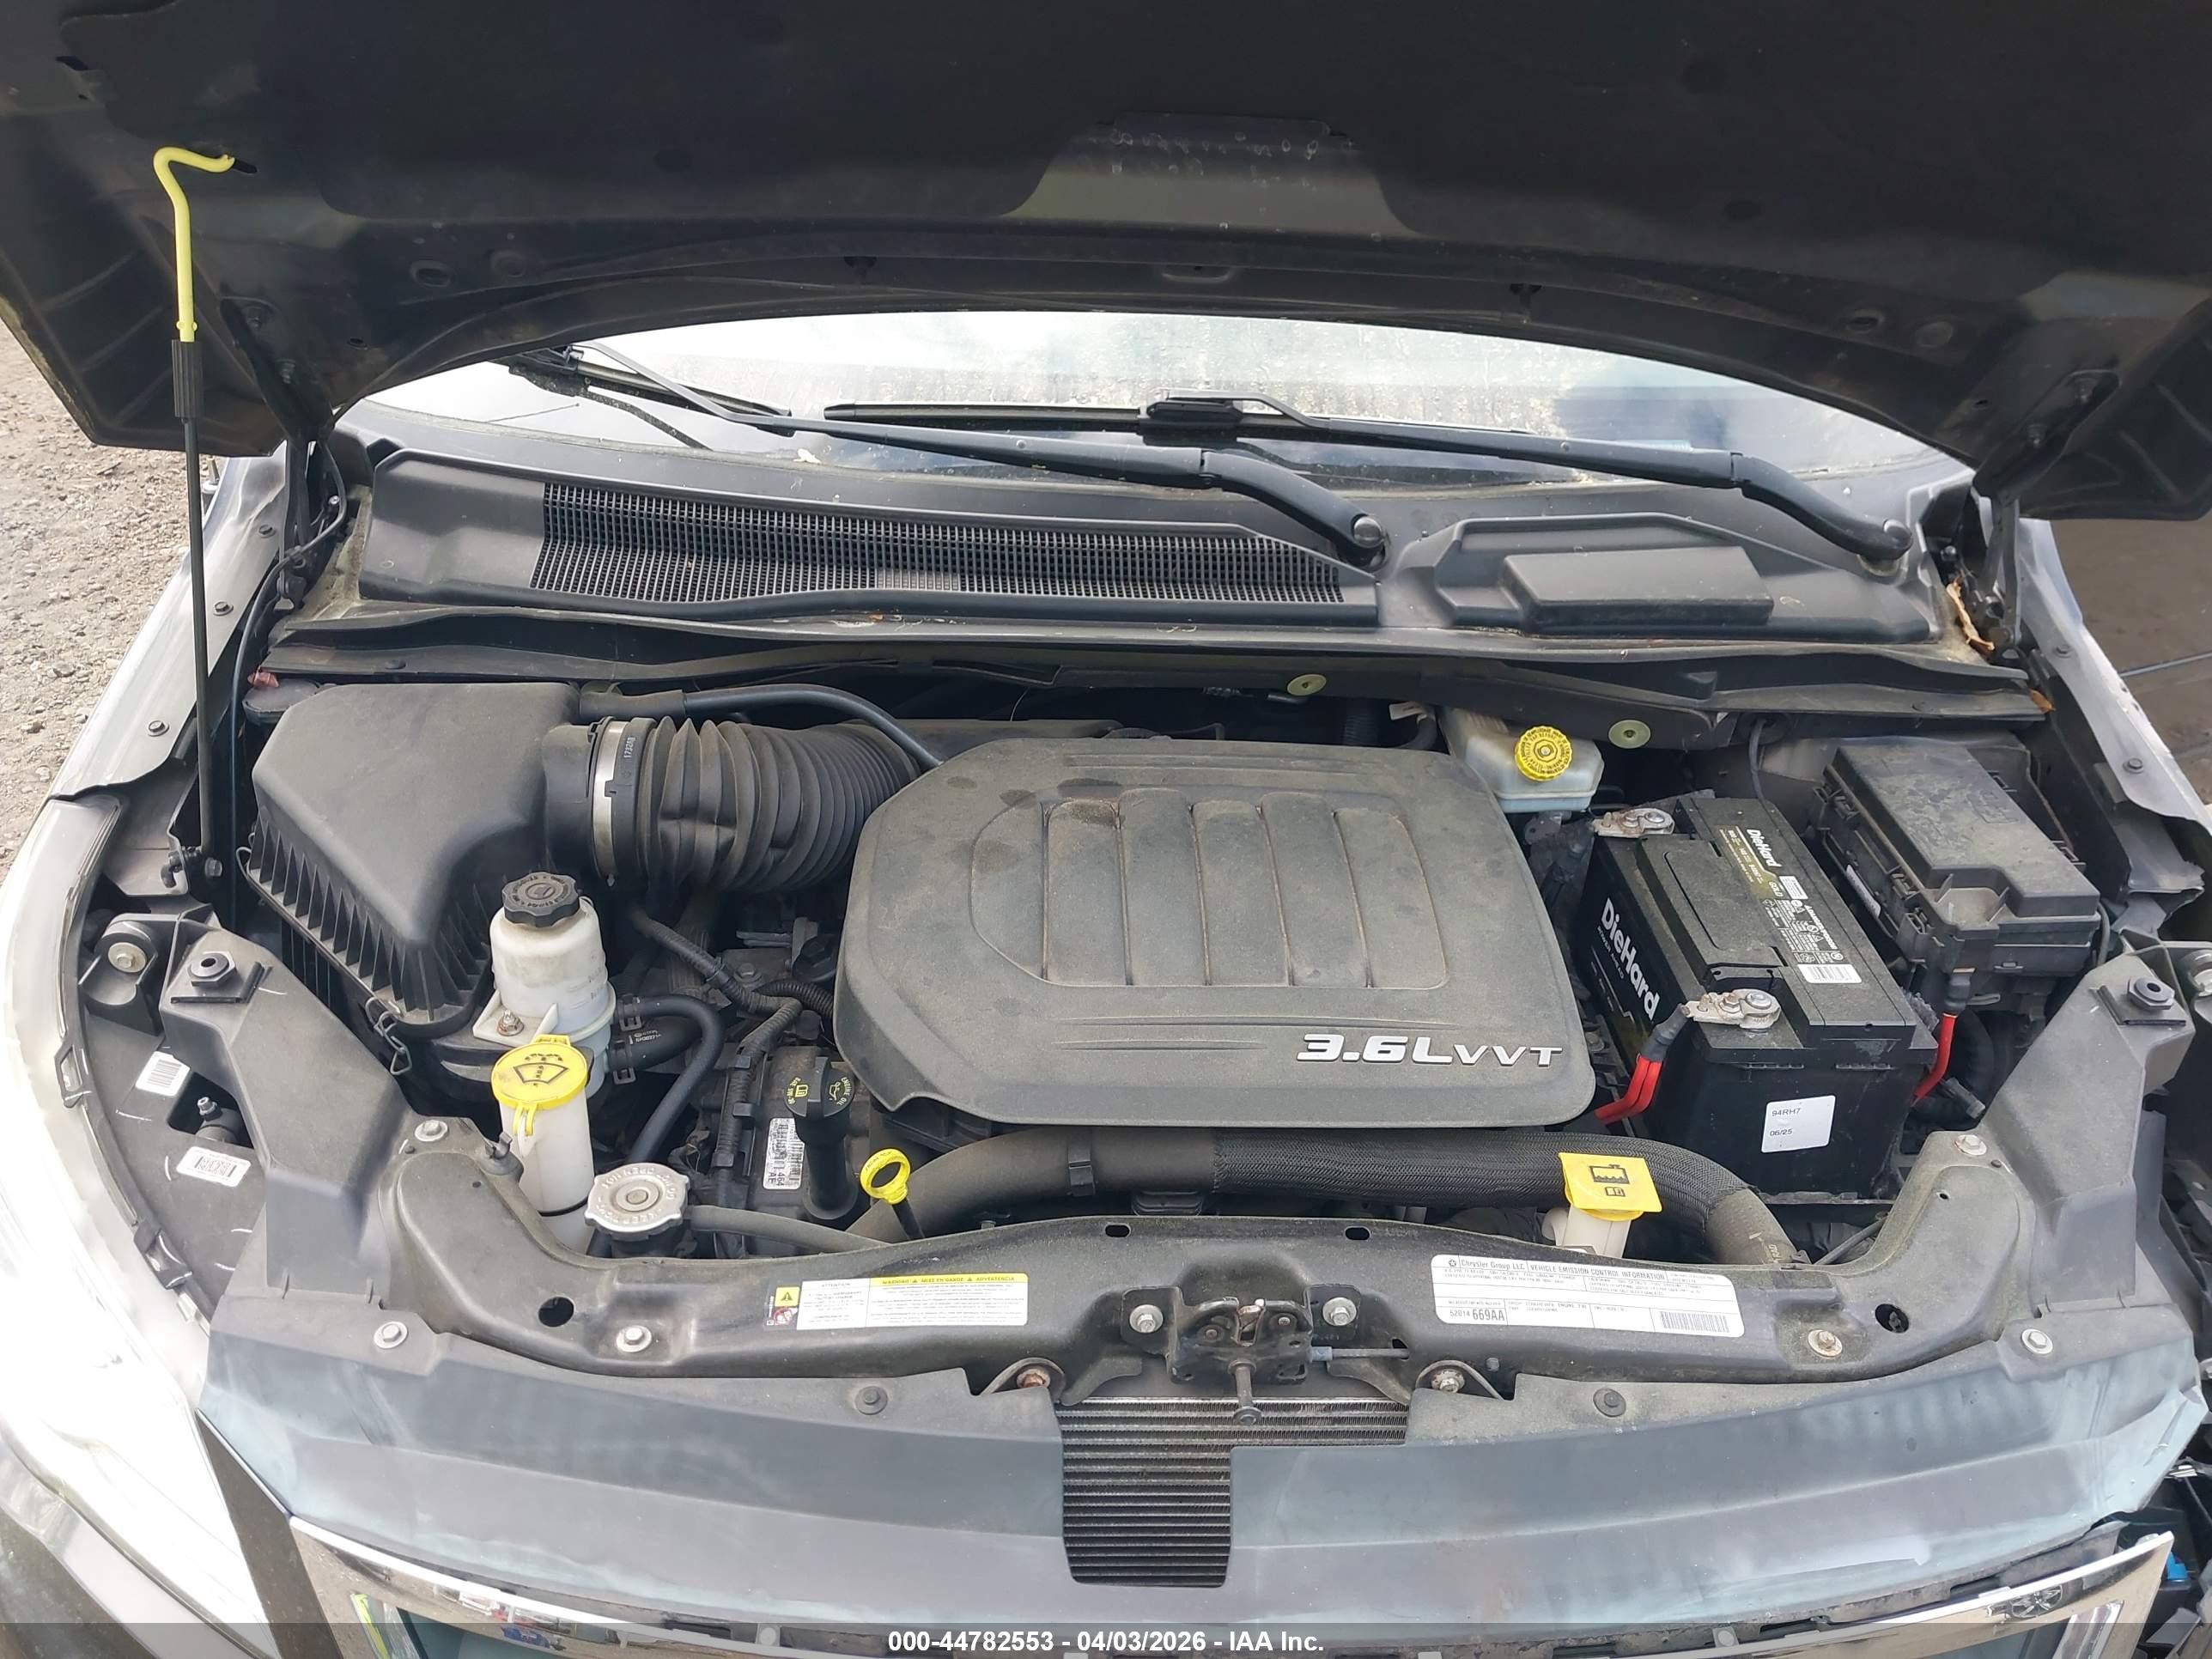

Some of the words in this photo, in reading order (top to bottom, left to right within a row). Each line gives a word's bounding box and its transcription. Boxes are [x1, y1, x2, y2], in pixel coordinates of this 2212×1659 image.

[1747, 829, 1783, 867] DieHard
[1769, 881, 1784, 897] GOLD
[1601, 897, 1660, 1021] DieHard
[1454, 1043, 1563, 1067] VVT
[842, 1077, 852, 1097] ENGINE
[1771, 1108, 1802, 1117] 94RH7
[1462, 1260, 1488, 1269] Chrysler
[1490, 1261, 1510, 1270] Group
[1530, 1264, 1556, 1273] VEHICLE
[1559, 1266, 1589, 1275] EMISSION
[1591, 1268, 1619, 1278] CONTROL
[1622, 1270, 1665, 1280] INFORMATION
[1472, 1309, 1505, 1321] 669AA
